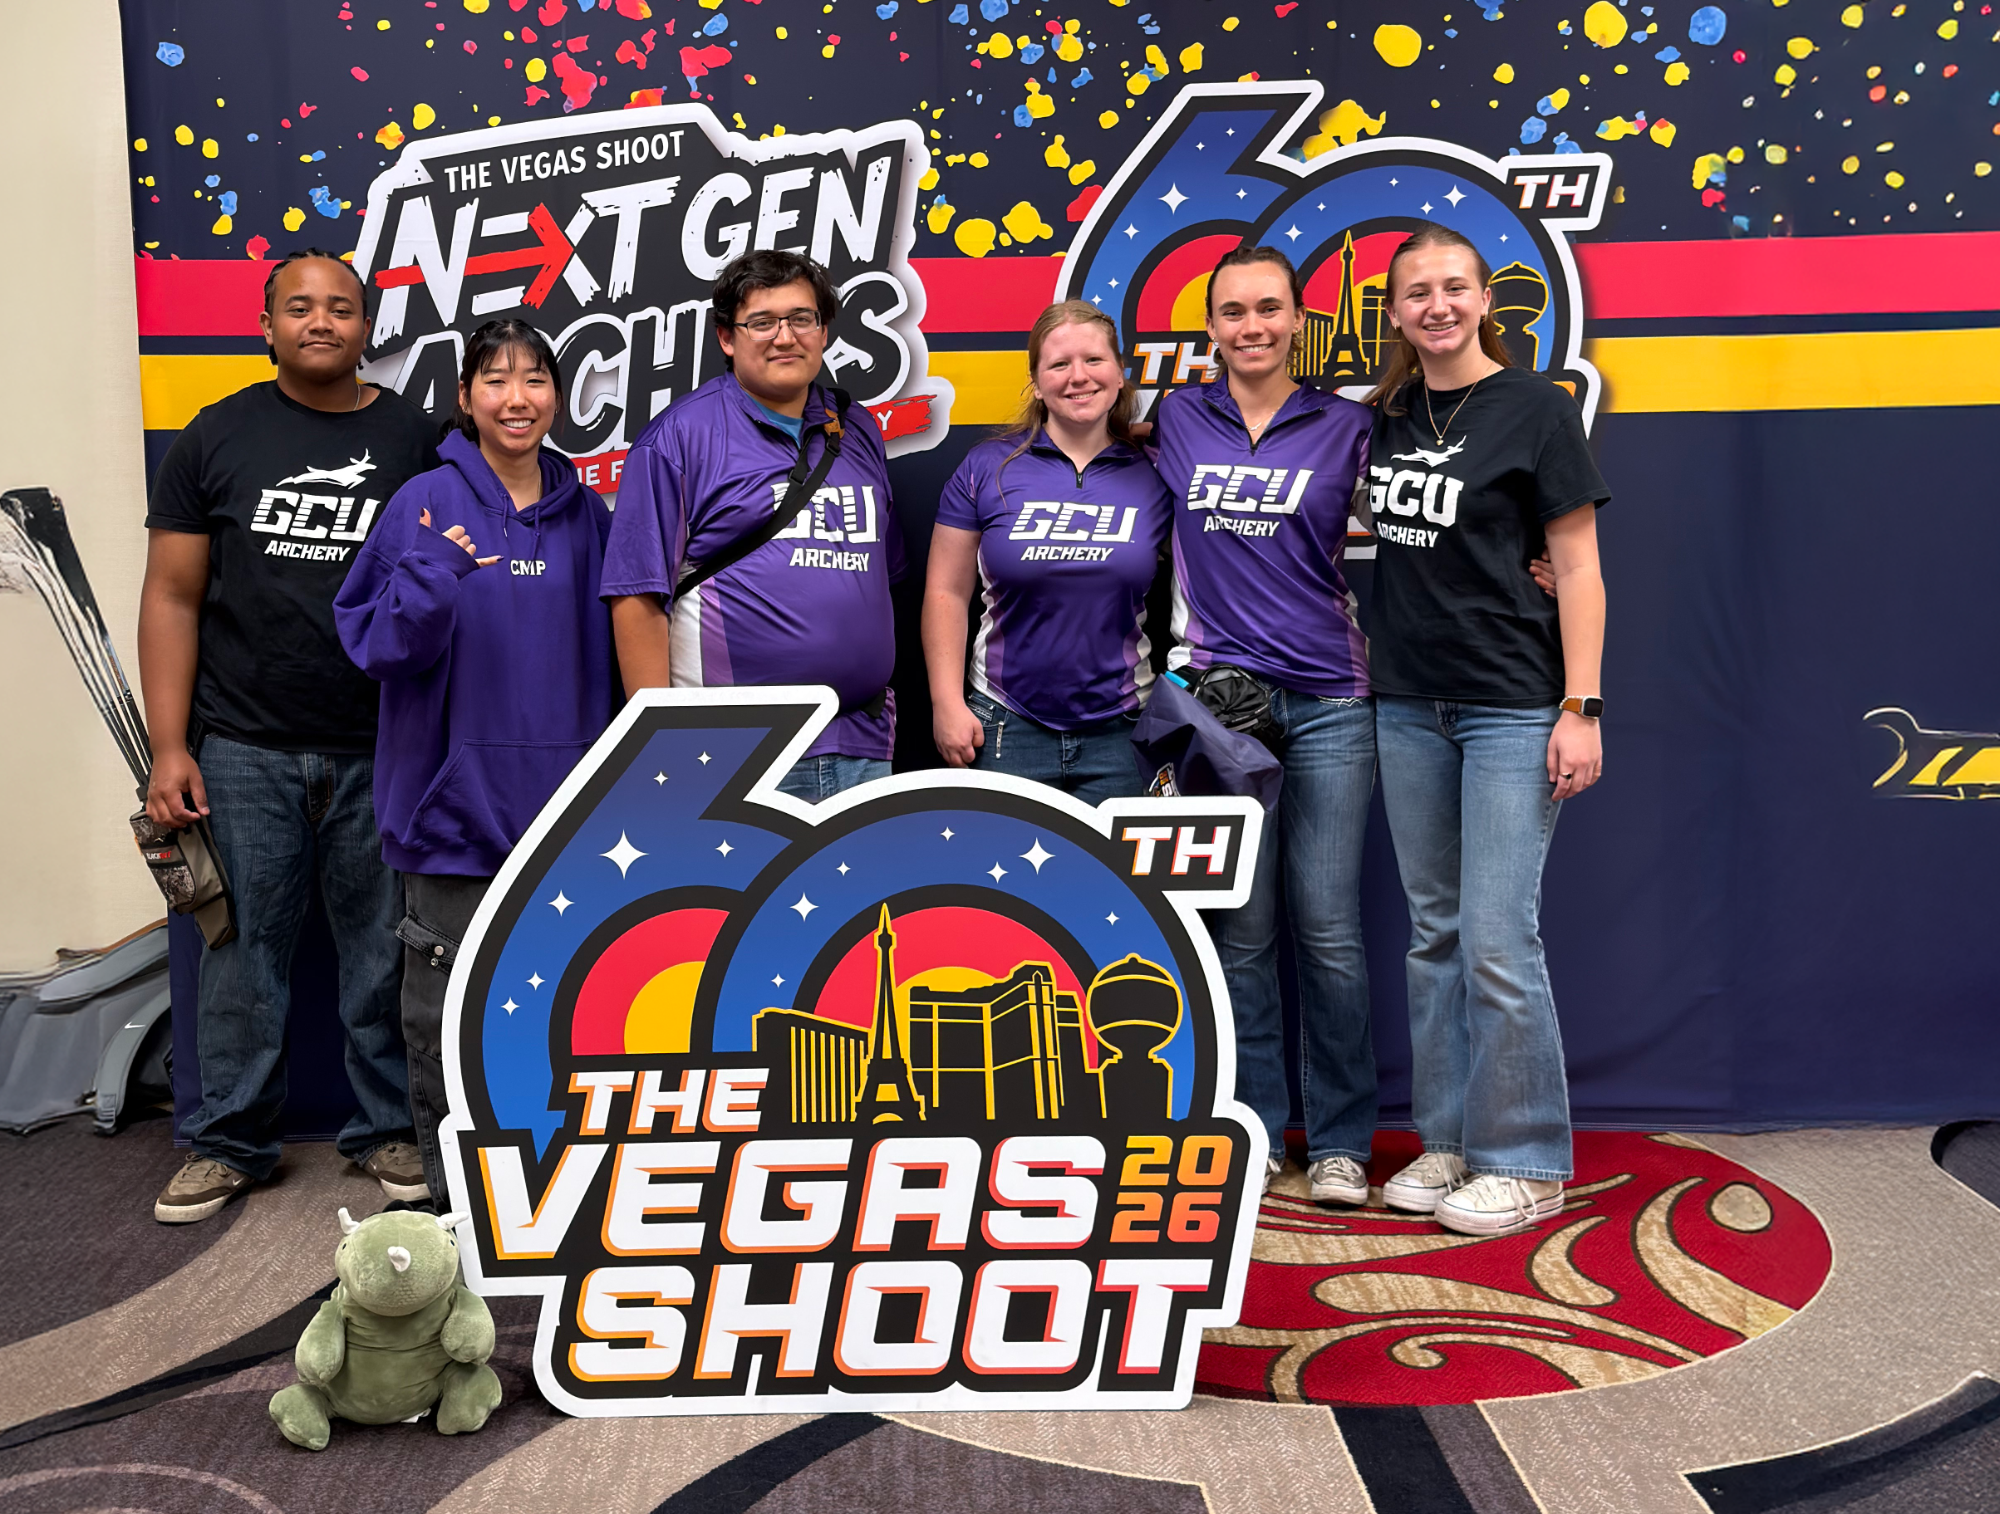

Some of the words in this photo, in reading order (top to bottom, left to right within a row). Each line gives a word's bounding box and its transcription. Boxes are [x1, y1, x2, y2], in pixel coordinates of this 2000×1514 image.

[444, 161, 492, 193] THE
[500, 145, 587, 184] VEGAS
[596, 130, 685, 169] SHOOT
[371, 175, 681, 349] NEXT
[681, 155, 893, 281] GEN
[1133, 341, 1219, 385] TH
[1187, 464, 1314, 515] GCU
[1370, 465, 1465, 528] GCU
[250, 488, 381, 542] GCU
[1008, 501, 1139, 543] GCU
[1203, 515, 1280, 537] ARCHERY
[1377, 521, 1439, 548] ARCHERY
[264, 540, 350, 562] ARCHERY
[510, 559, 546, 576] CMP
[789, 548, 870, 572] ARCHERY
[1021, 546, 1114, 562] ARCHERY
[568, 1067, 769, 1134] THE
[477, 1135, 1107, 1260] VEGAS
[568, 1259, 1212, 1382] SHOOT
